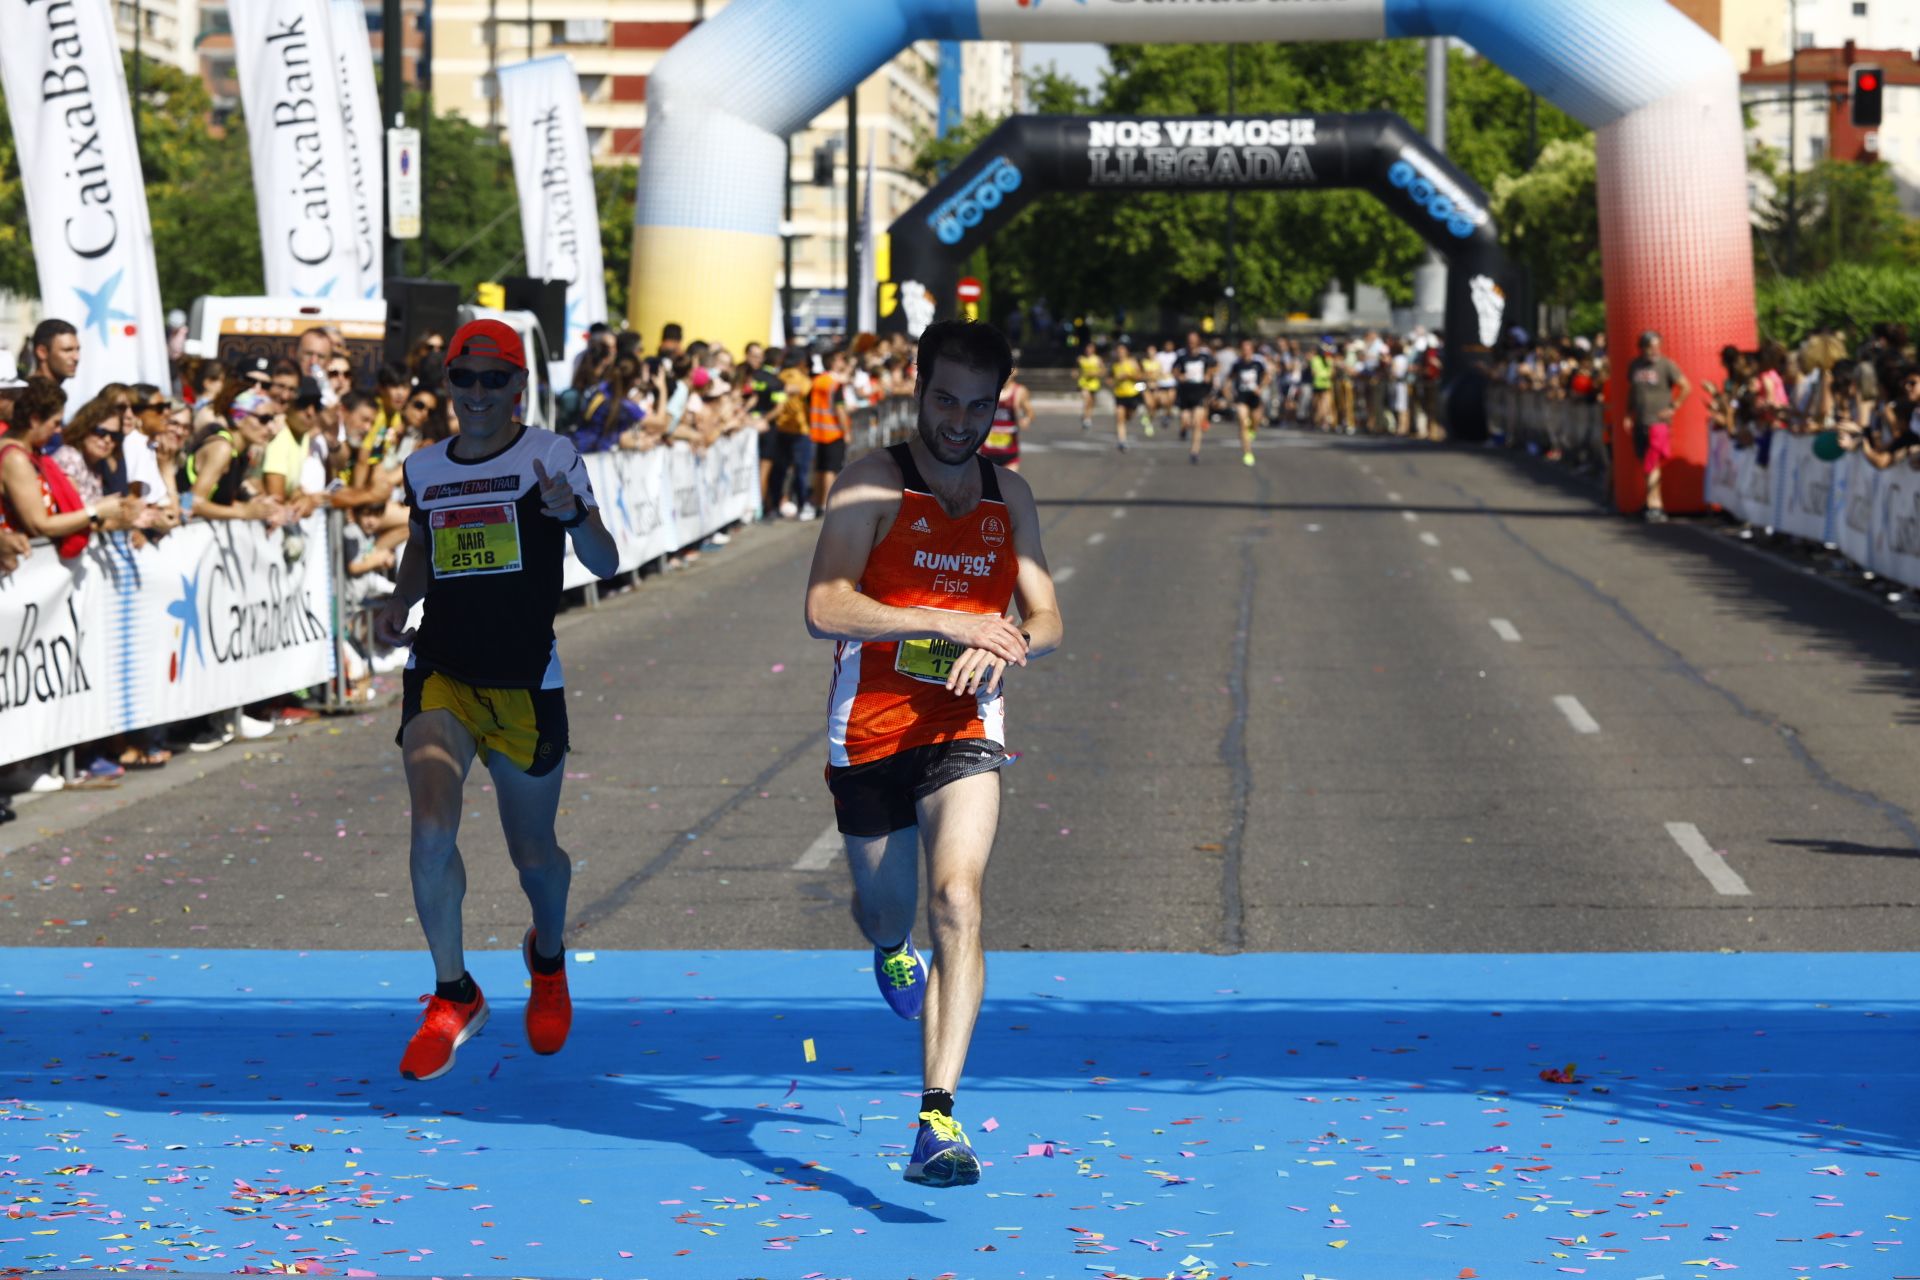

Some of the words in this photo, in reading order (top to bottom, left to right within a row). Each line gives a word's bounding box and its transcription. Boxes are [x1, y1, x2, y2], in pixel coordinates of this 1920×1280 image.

[26, 0, 118, 260] CaixaBan
[1088, 120, 1162, 147] NOS
[1164, 118, 1291, 147] VEMOS
[265, 15, 335, 266] CaixaBank
[1087, 146, 1316, 184] LLEGADA
[464, 481, 488, 494] ETNA
[494, 476, 517, 490] TRAIL
[910, 525, 932, 534] adidas
[457, 531, 485, 551] NAIR
[451, 551, 495, 567] 2518
[932, 574, 969, 593] Fisio
[929, 638, 967, 658] MIGU
[931, 658, 955, 675] 17
